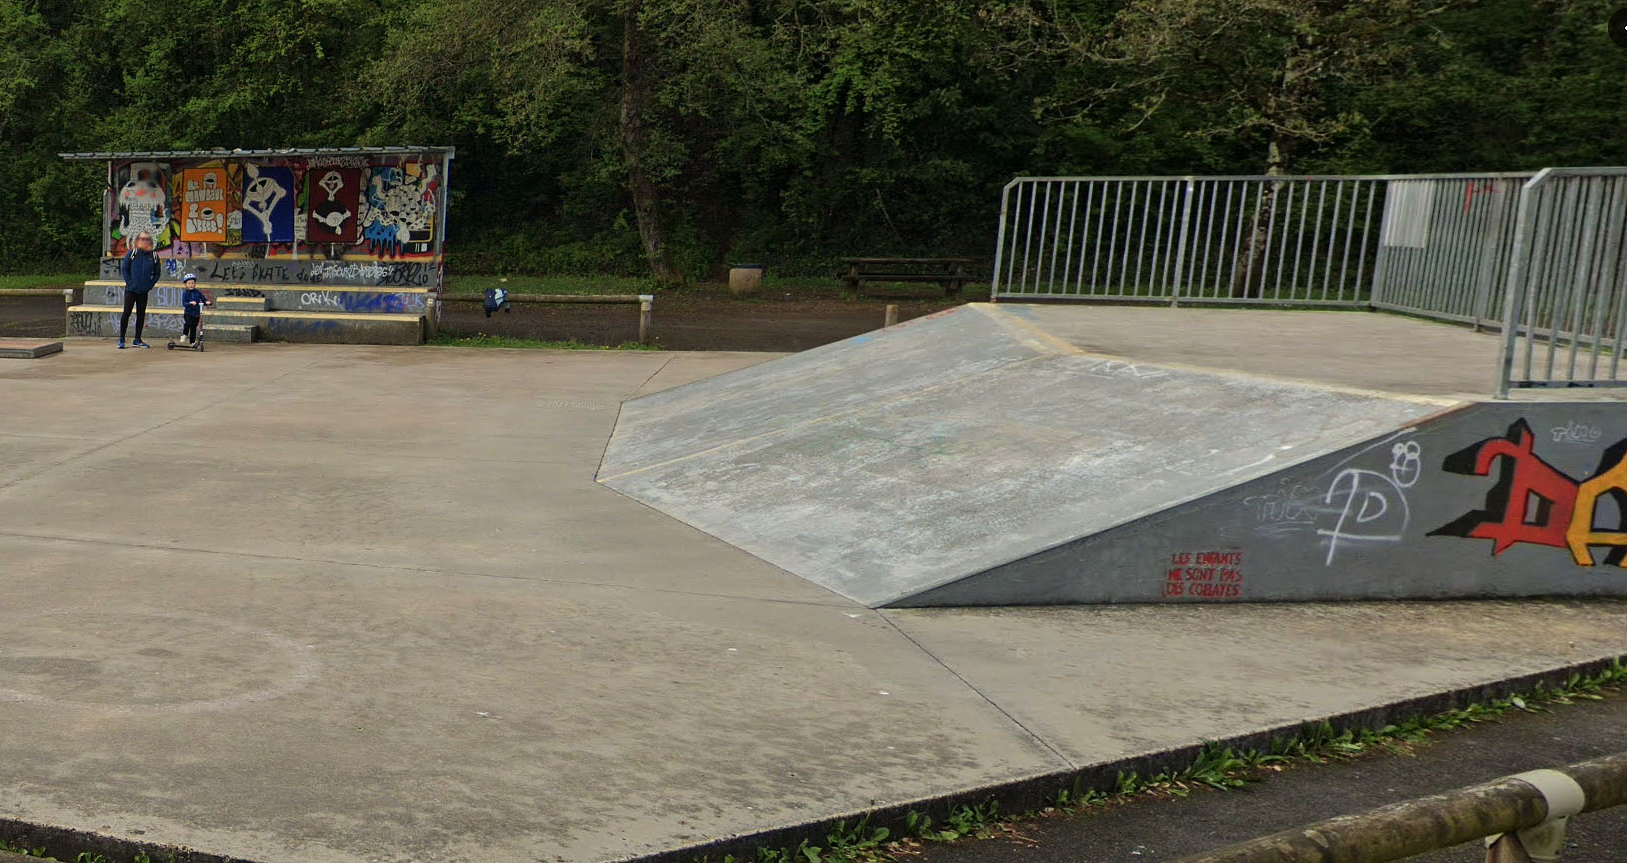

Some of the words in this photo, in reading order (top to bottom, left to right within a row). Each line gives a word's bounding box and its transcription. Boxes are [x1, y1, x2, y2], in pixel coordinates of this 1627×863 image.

[1172, 552, 1192, 566] LES
[1186, 568, 1217, 582] SONT
[1220, 568, 1243, 583] PAS
